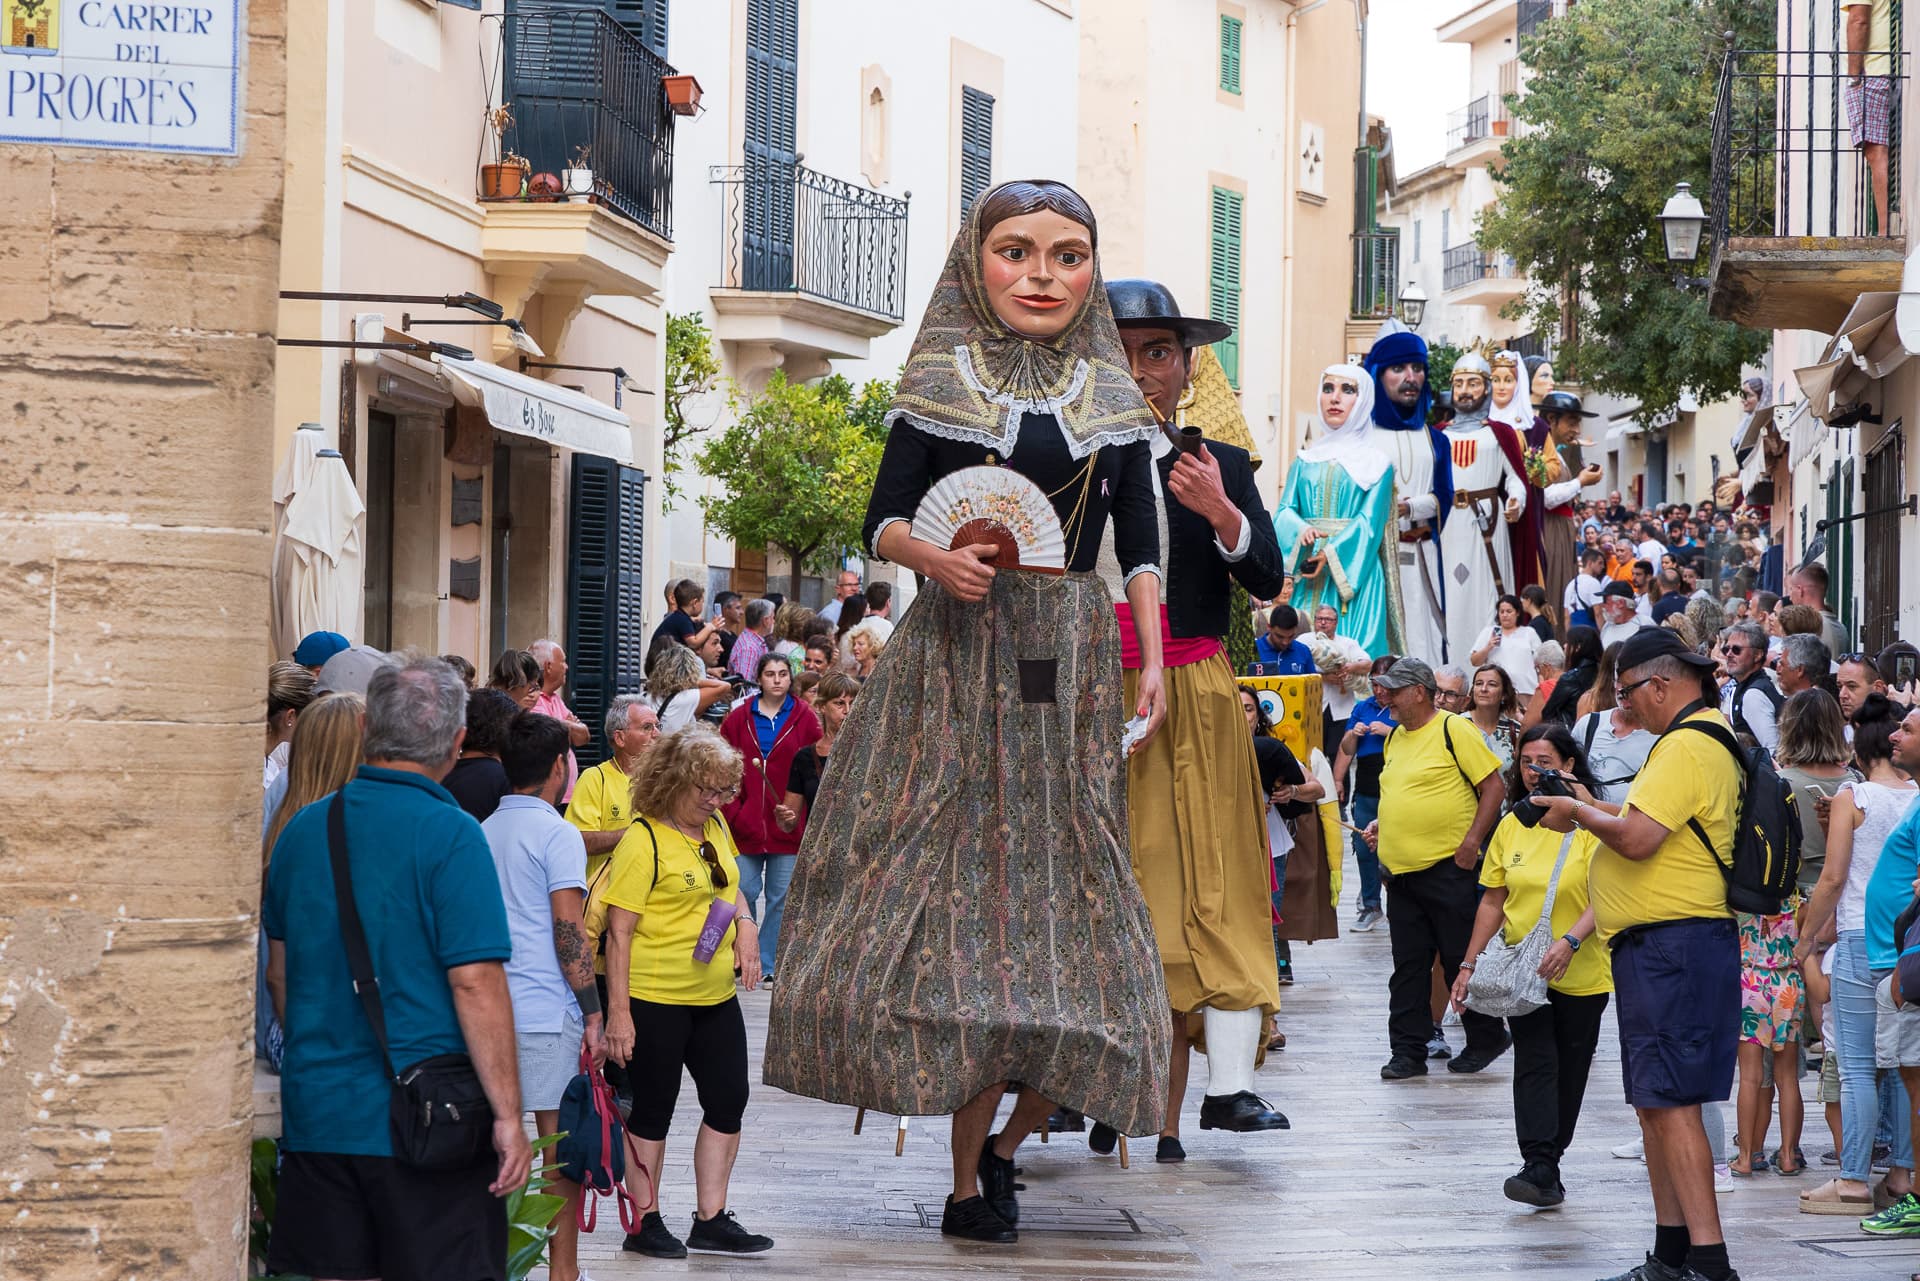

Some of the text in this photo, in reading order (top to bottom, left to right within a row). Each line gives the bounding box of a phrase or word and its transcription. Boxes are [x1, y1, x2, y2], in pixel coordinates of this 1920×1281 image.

[79, 1, 213, 35] CARRER
[115, 43, 170, 64] DEL
[7, 68, 198, 128] PROGRÉS
[1255, 663, 1264, 676] B
